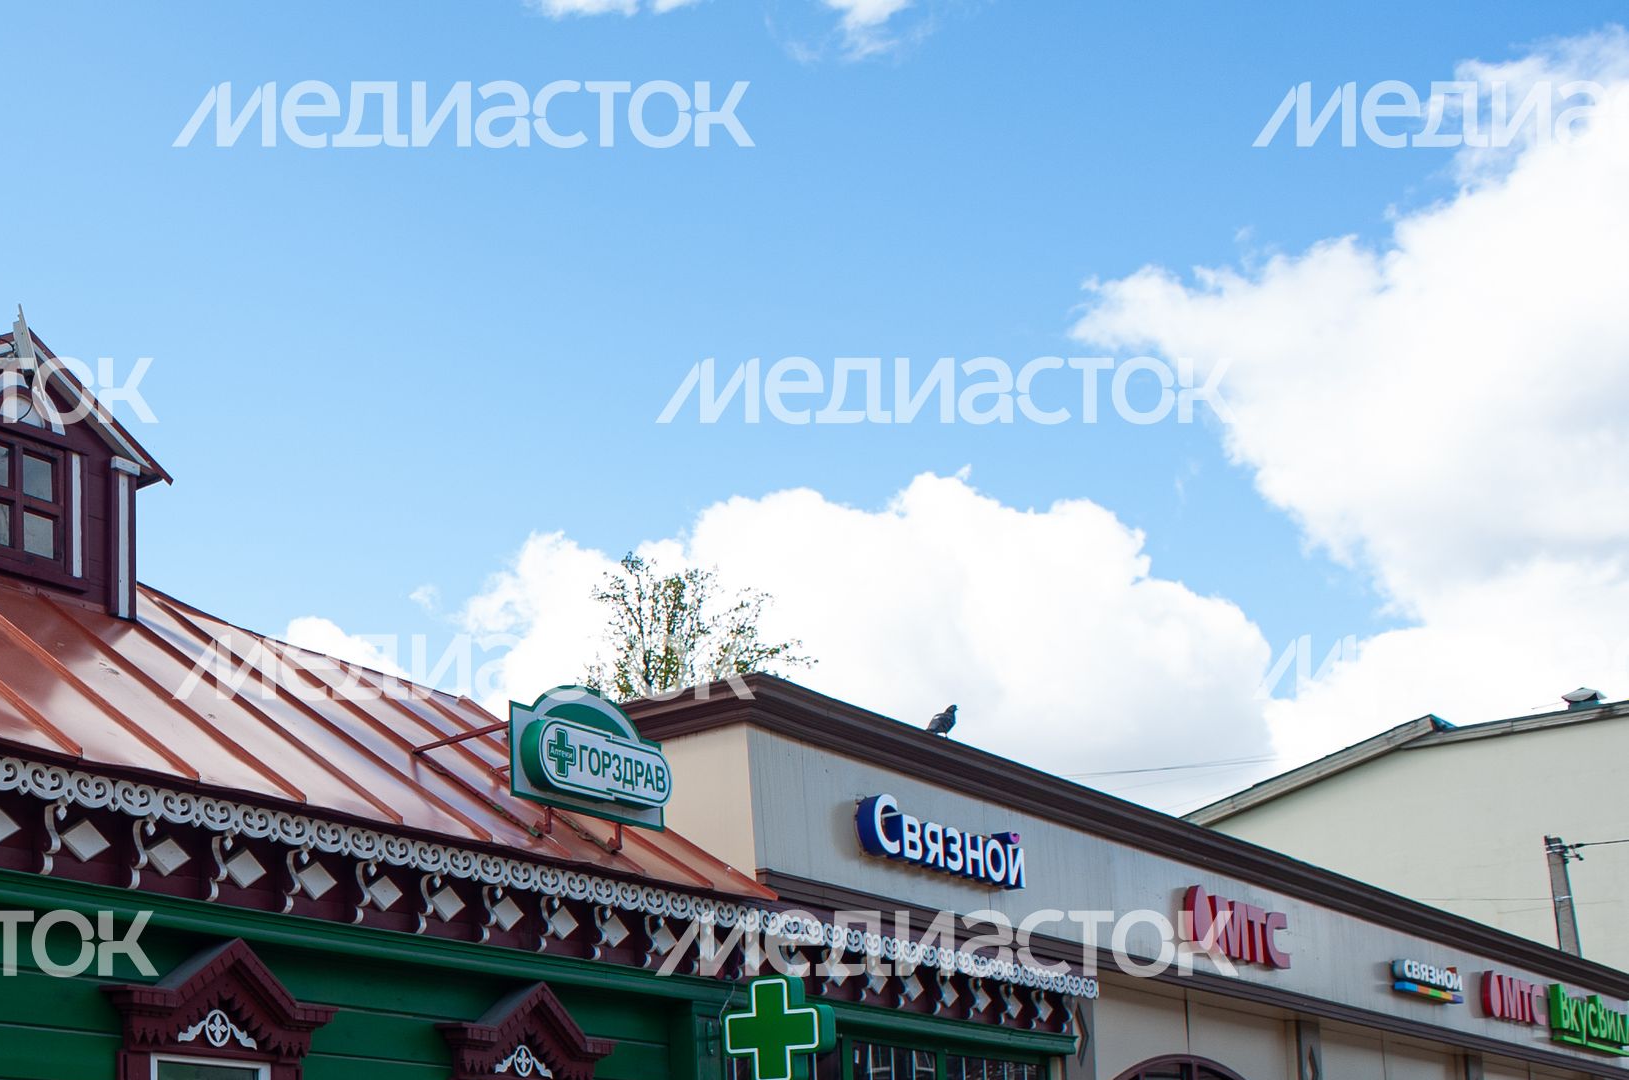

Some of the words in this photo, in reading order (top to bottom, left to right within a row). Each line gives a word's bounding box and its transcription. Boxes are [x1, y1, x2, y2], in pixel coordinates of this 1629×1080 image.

[578, 744, 667, 793] ГОРЗДРАВ
[1211, 895, 1291, 969] МТС
[1497, 974, 1546, 1026] МТС
